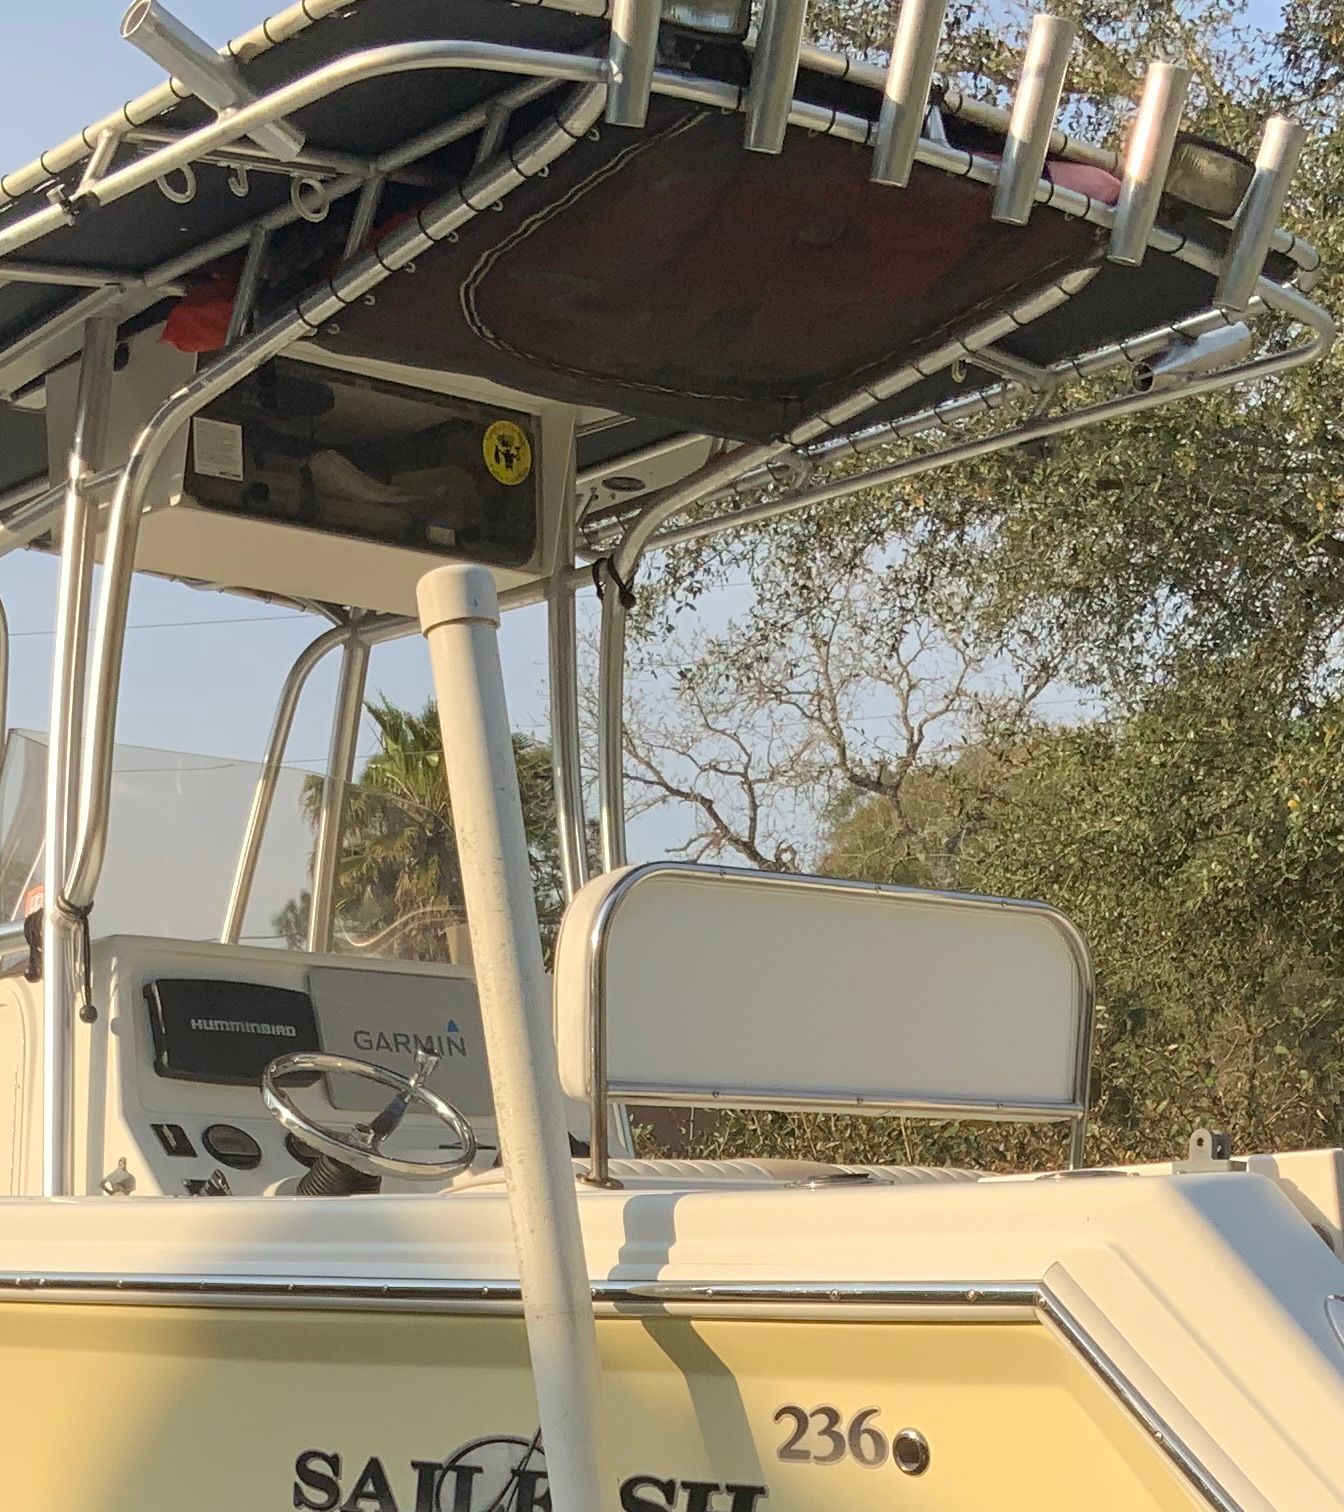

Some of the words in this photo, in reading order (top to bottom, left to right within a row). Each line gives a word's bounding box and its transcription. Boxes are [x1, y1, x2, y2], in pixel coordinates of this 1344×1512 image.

[190, 1018, 297, 1038] HUMMINBIRD
[353, 1030, 467, 1057] GARMIN
[773, 1404, 889, 1467] 236
